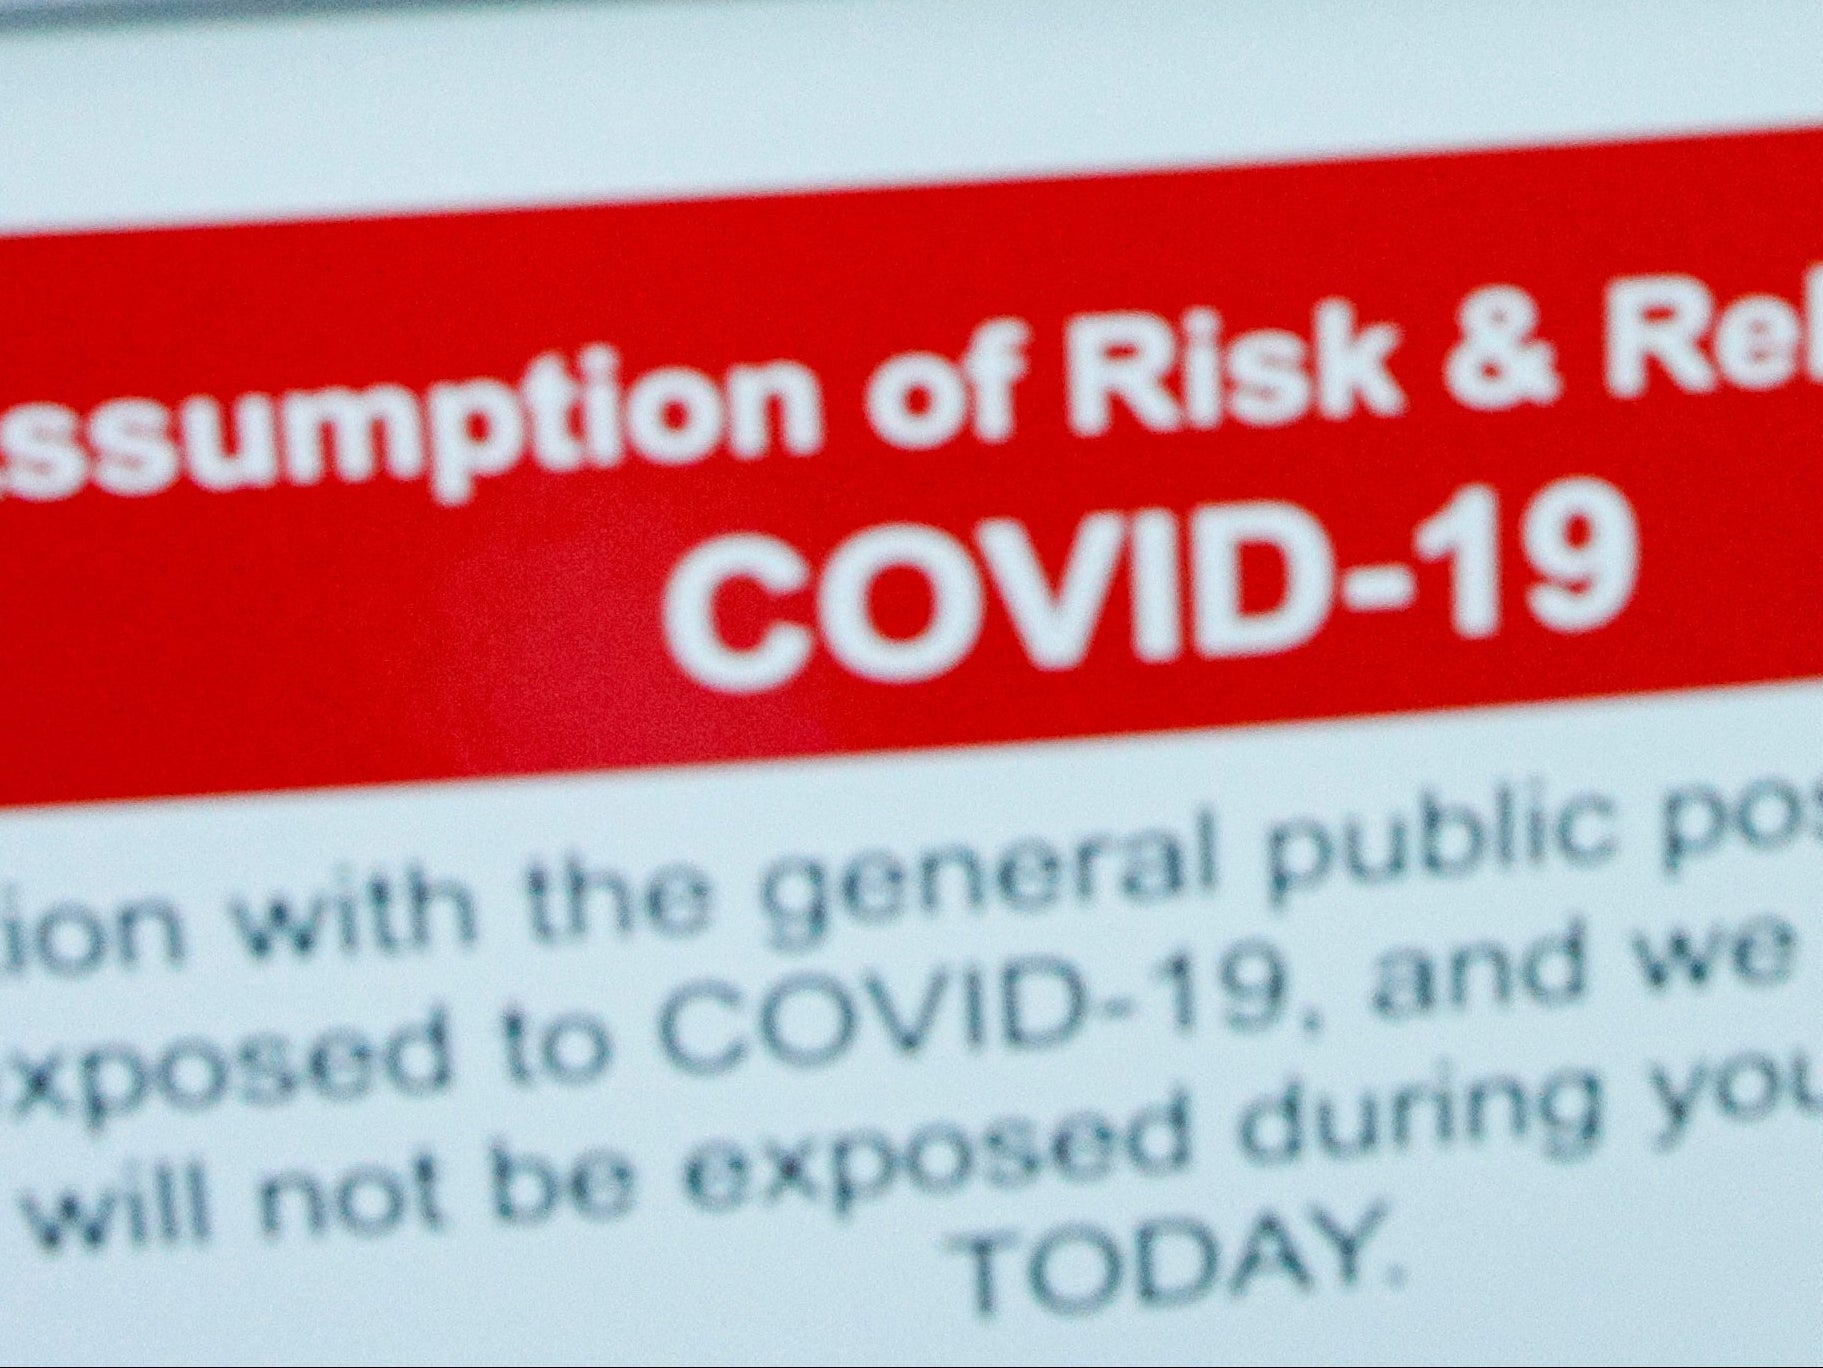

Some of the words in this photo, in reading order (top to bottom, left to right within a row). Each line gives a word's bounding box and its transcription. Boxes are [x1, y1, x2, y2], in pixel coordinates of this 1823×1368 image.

[865, 317, 1030, 449] of
[1064, 297, 1405, 437] Risk
[1443, 283, 1561, 411] &
[660, 475, 1641, 695] COVID-19
[232, 864, 478, 964] with
[524, 852, 712, 947] the
[758, 807, 1218, 952] general
[1264, 778, 1616, 912] public
[498, 1004, 615, 1088] to
[655, 938, 1324, 1076] COVID-19,
[1370, 922, 1588, 1020] and
[1631, 912, 1799, 995] we
[18, 1158, 212, 1254] will
[255, 1147, 447, 1237] not
[486, 1138, 639, 1227] be
[679, 1088, 1194, 1221] exposed
[1235, 1061, 1606, 1165] during
[944, 1199, 1406, 1318] TODAY.
